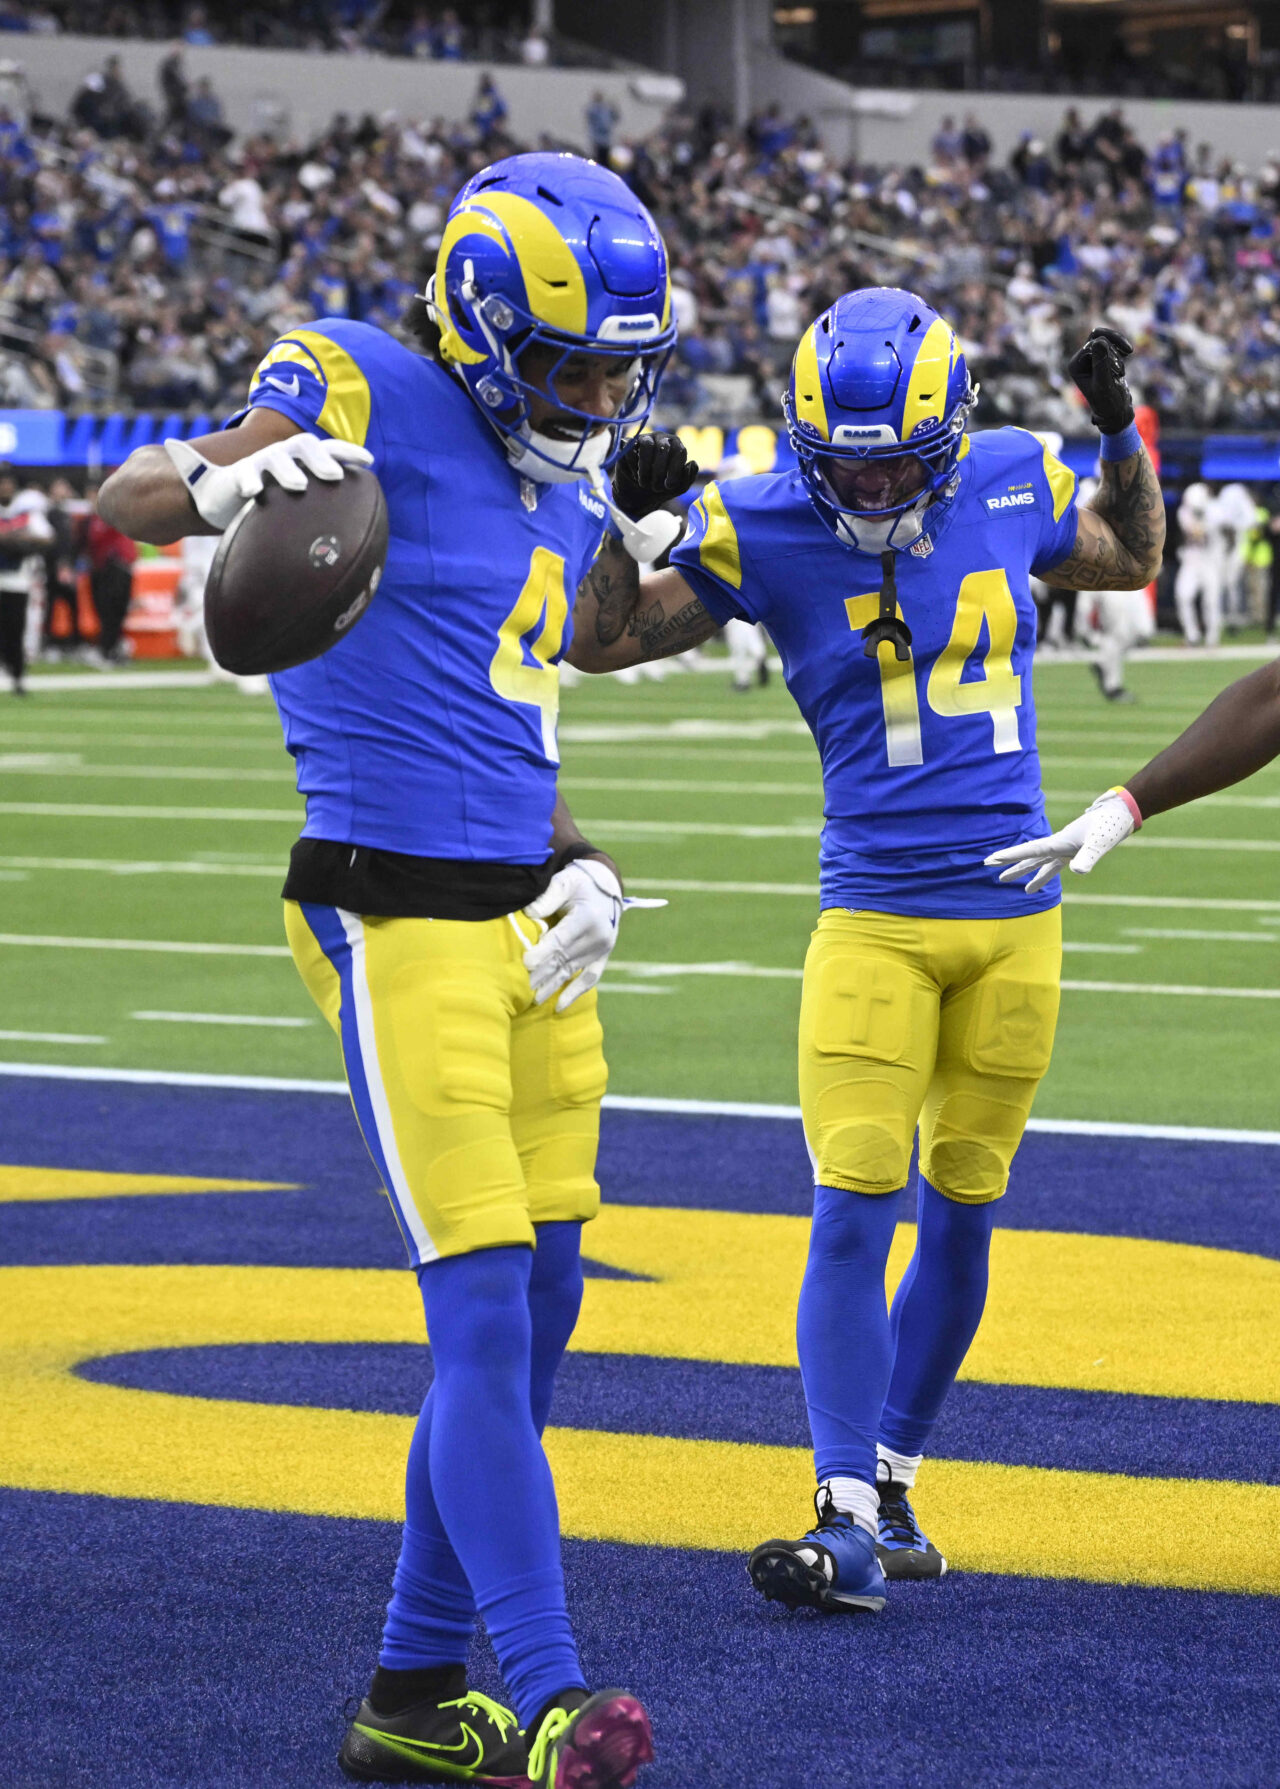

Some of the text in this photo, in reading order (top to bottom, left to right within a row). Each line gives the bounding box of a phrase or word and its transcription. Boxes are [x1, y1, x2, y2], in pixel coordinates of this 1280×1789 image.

[986, 492, 1035, 510] RAMS
[489, 546, 567, 764] 4
[844, 568, 1023, 767] 14
